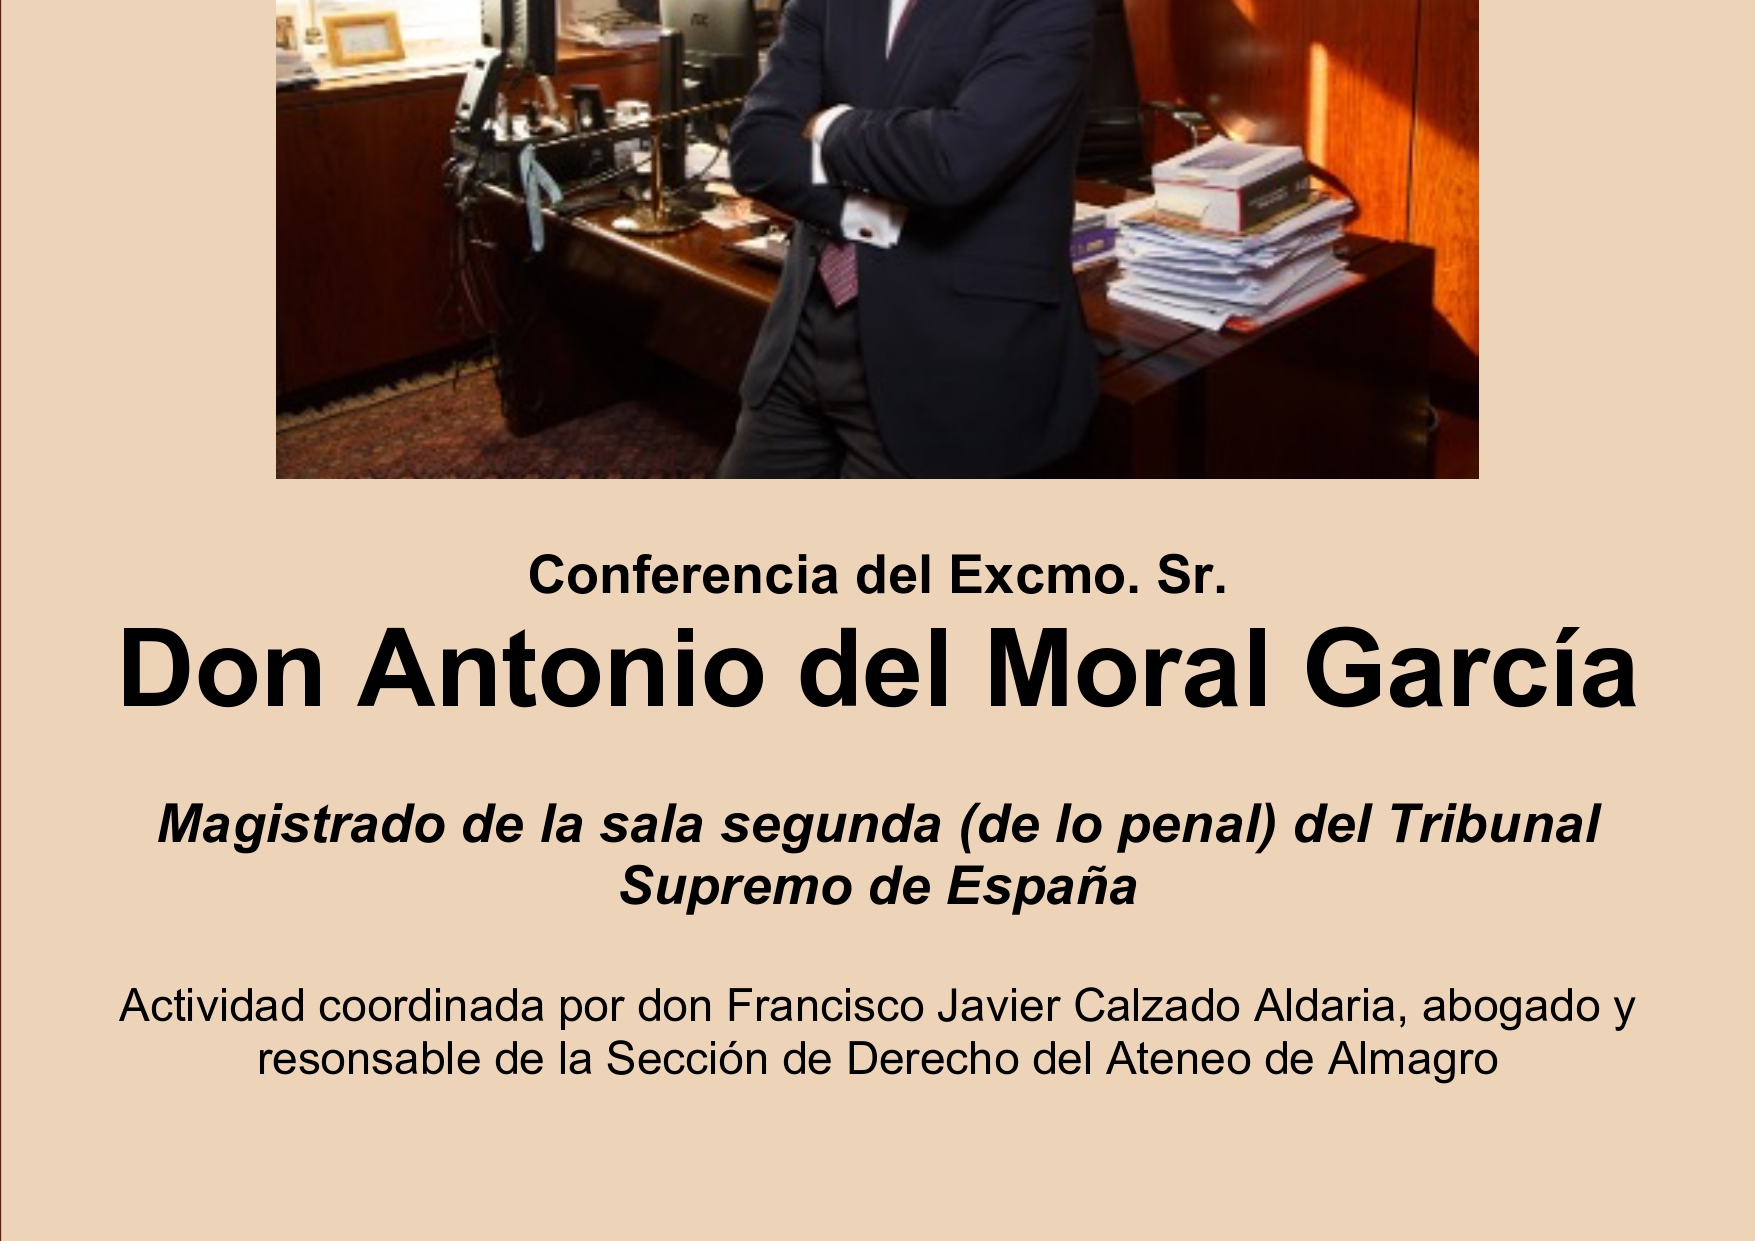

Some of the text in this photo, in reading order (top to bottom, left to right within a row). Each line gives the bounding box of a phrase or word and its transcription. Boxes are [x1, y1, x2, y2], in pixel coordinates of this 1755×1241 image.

[530, 553, 1225, 594] Conferencia del Excmo. Sr.
[124, 626, 1636, 708] Don Antonio del Moral García
[158, 802, 1602, 854] Magistrado de la sala segunda (de lo penal) del Tribunal
[620, 864, 1136, 915] Supremo de España
[119, 987, 1636, 1031] Actividad coordinada por don Francisco Javier Calzado Aldaria, abogado y
[260, 1040, 1497, 1084] resonsable de la Sección de Derecho del Ateneo de Almagro
